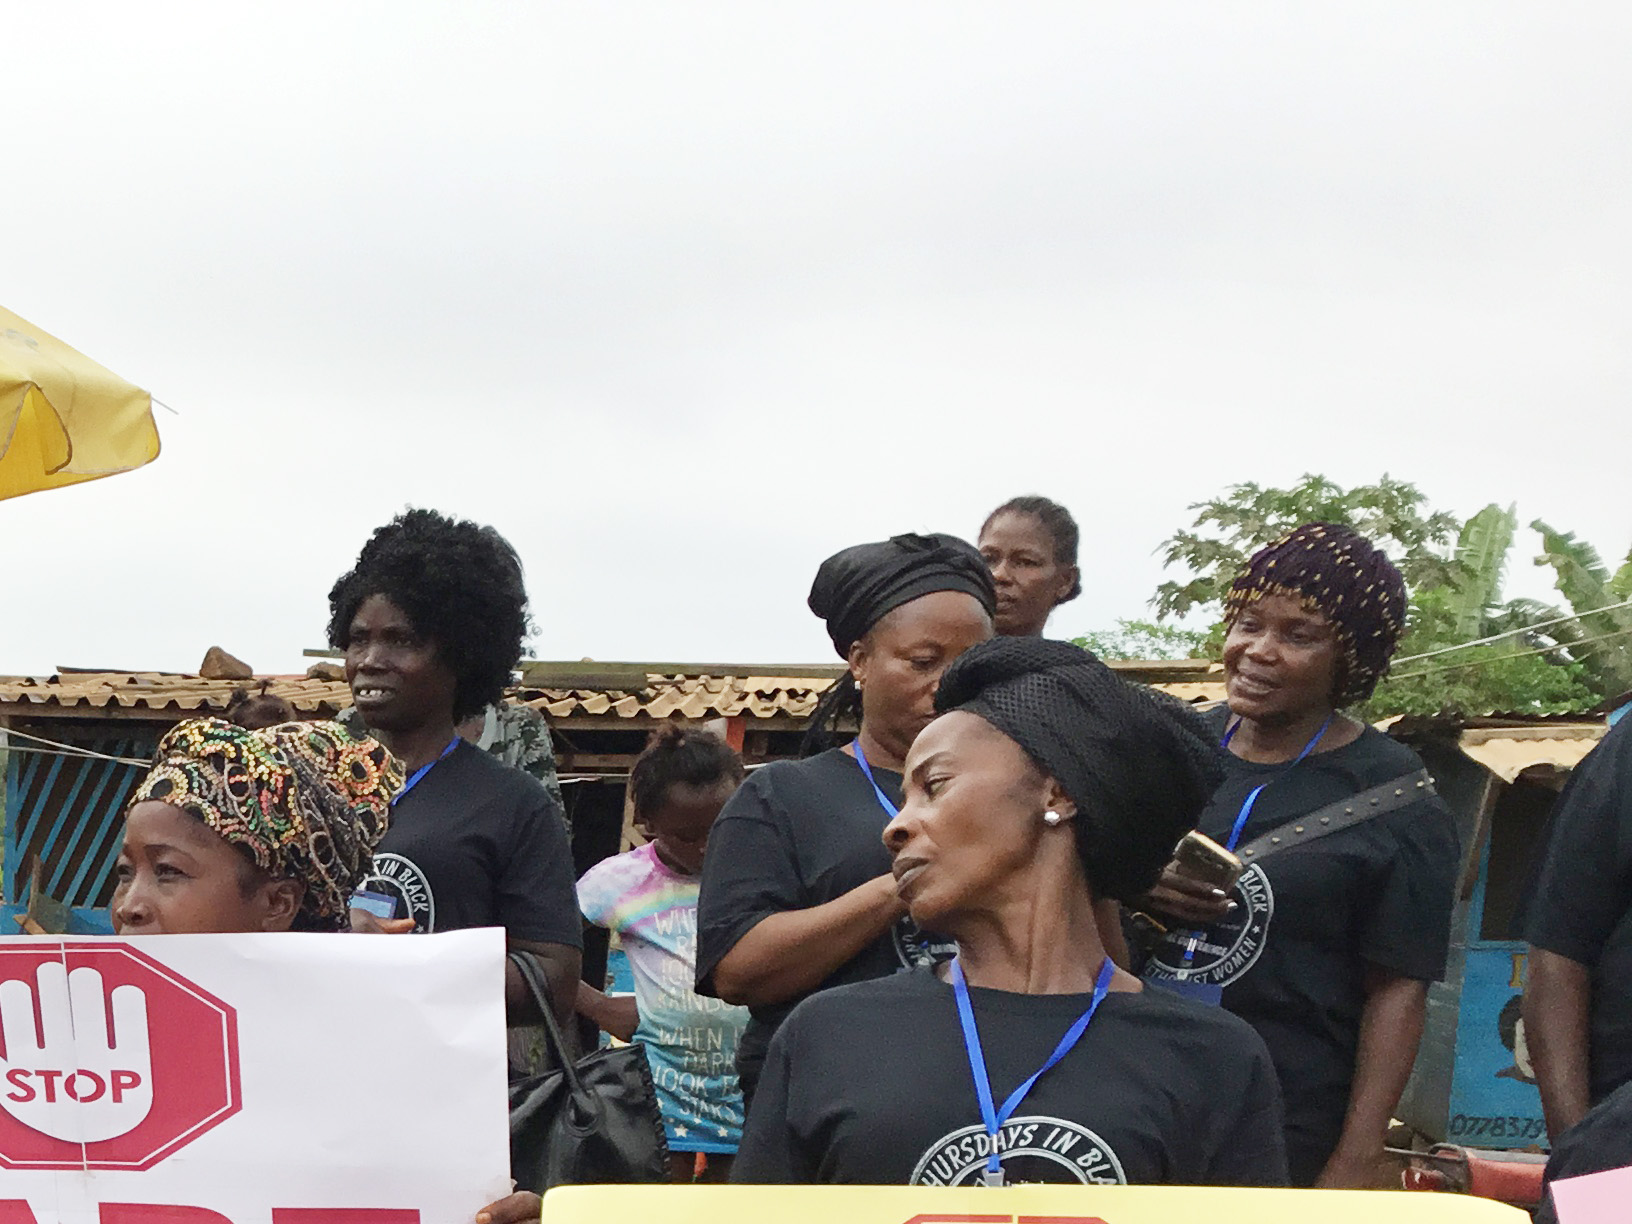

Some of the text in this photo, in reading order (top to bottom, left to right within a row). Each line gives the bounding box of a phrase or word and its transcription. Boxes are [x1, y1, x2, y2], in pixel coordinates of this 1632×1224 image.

[381, 860, 429, 912] IN BLACK
[1238, 869, 1268, 913] BLACK
[1211, 936, 1257, 981] WOMEN
[659, 1026, 723, 1051] WHEN
[5, 1067, 144, 1105] STOP
[921, 1123, 1040, 1187] HURSDAYS
[1042, 1127, 1082, 1155] IN
